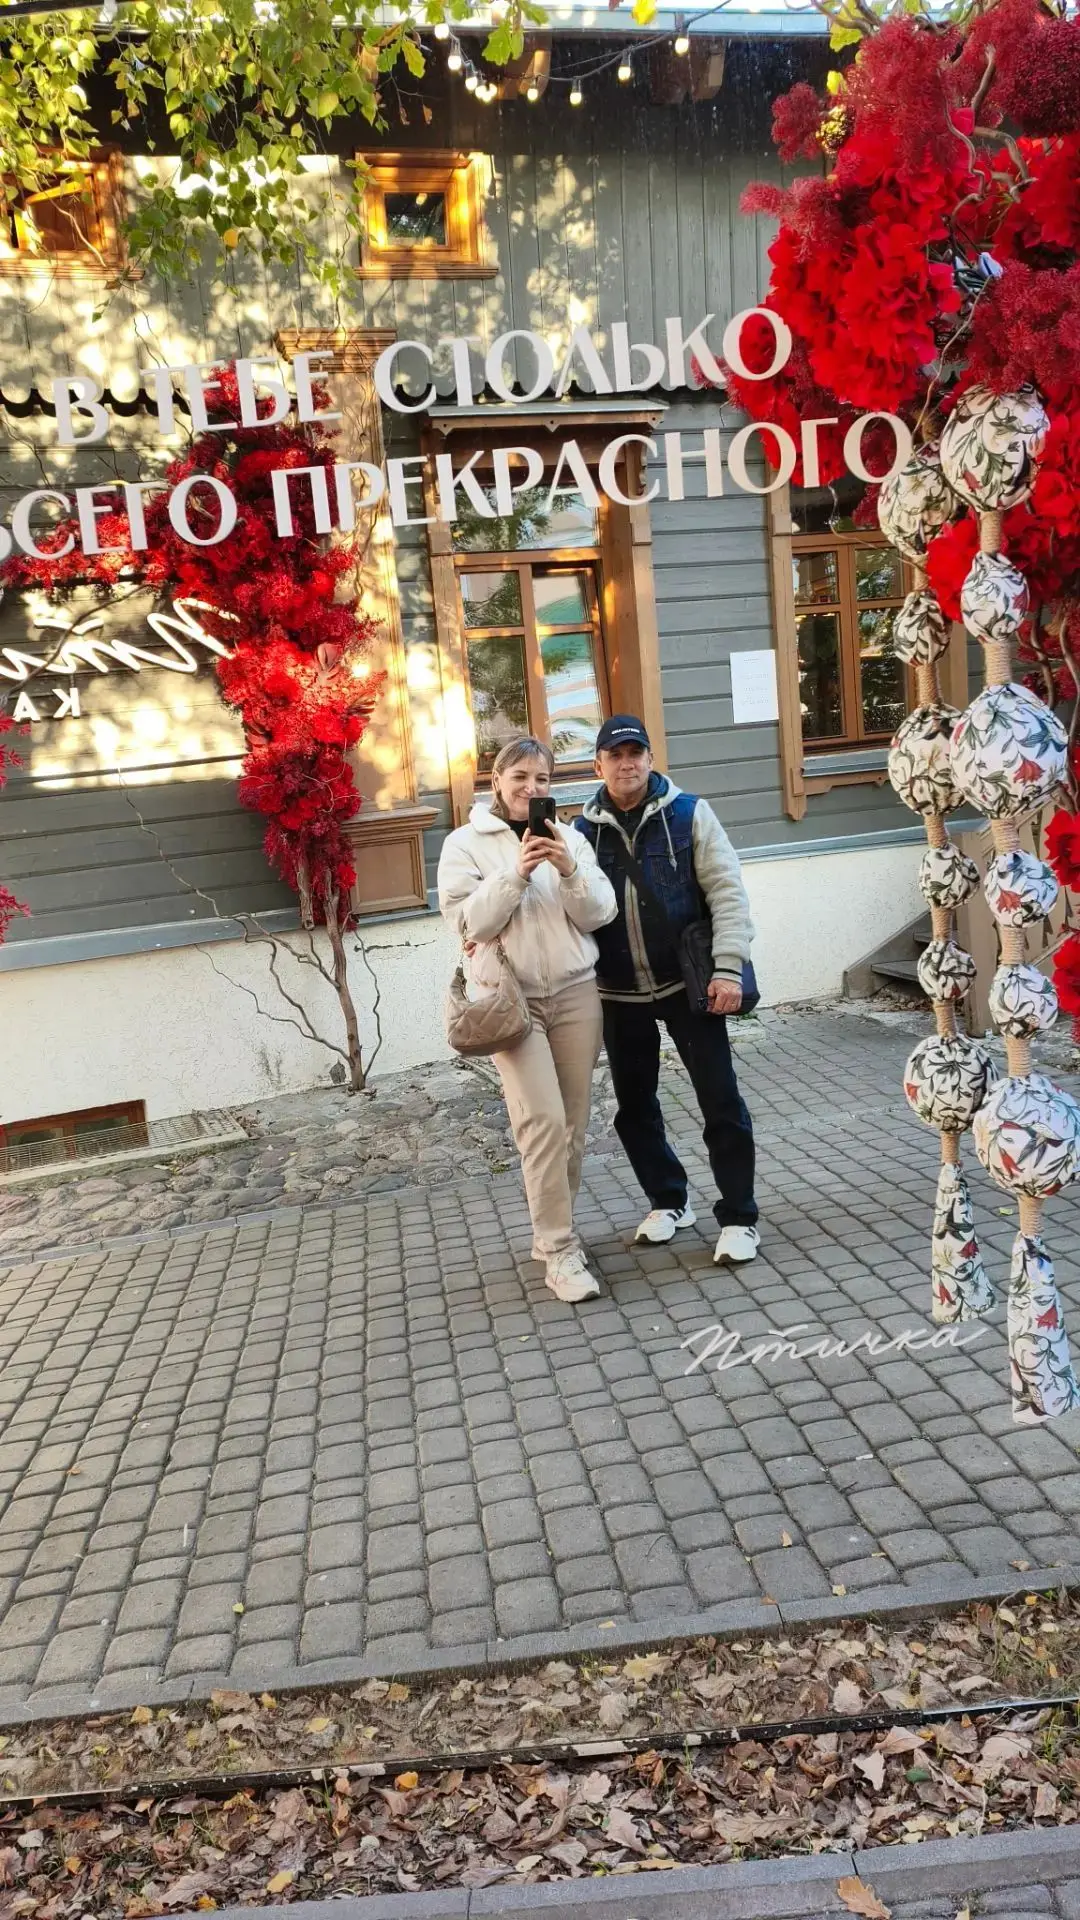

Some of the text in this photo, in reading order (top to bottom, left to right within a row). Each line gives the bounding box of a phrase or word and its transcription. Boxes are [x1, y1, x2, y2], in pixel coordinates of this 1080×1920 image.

[51, 306, 793, 446] В ТЕБЕ СТОЛЬКО
[0, 411, 914, 562] СЕГО ПРЕКРАСНОГО
[680, 1323, 991, 1375] Птичка
